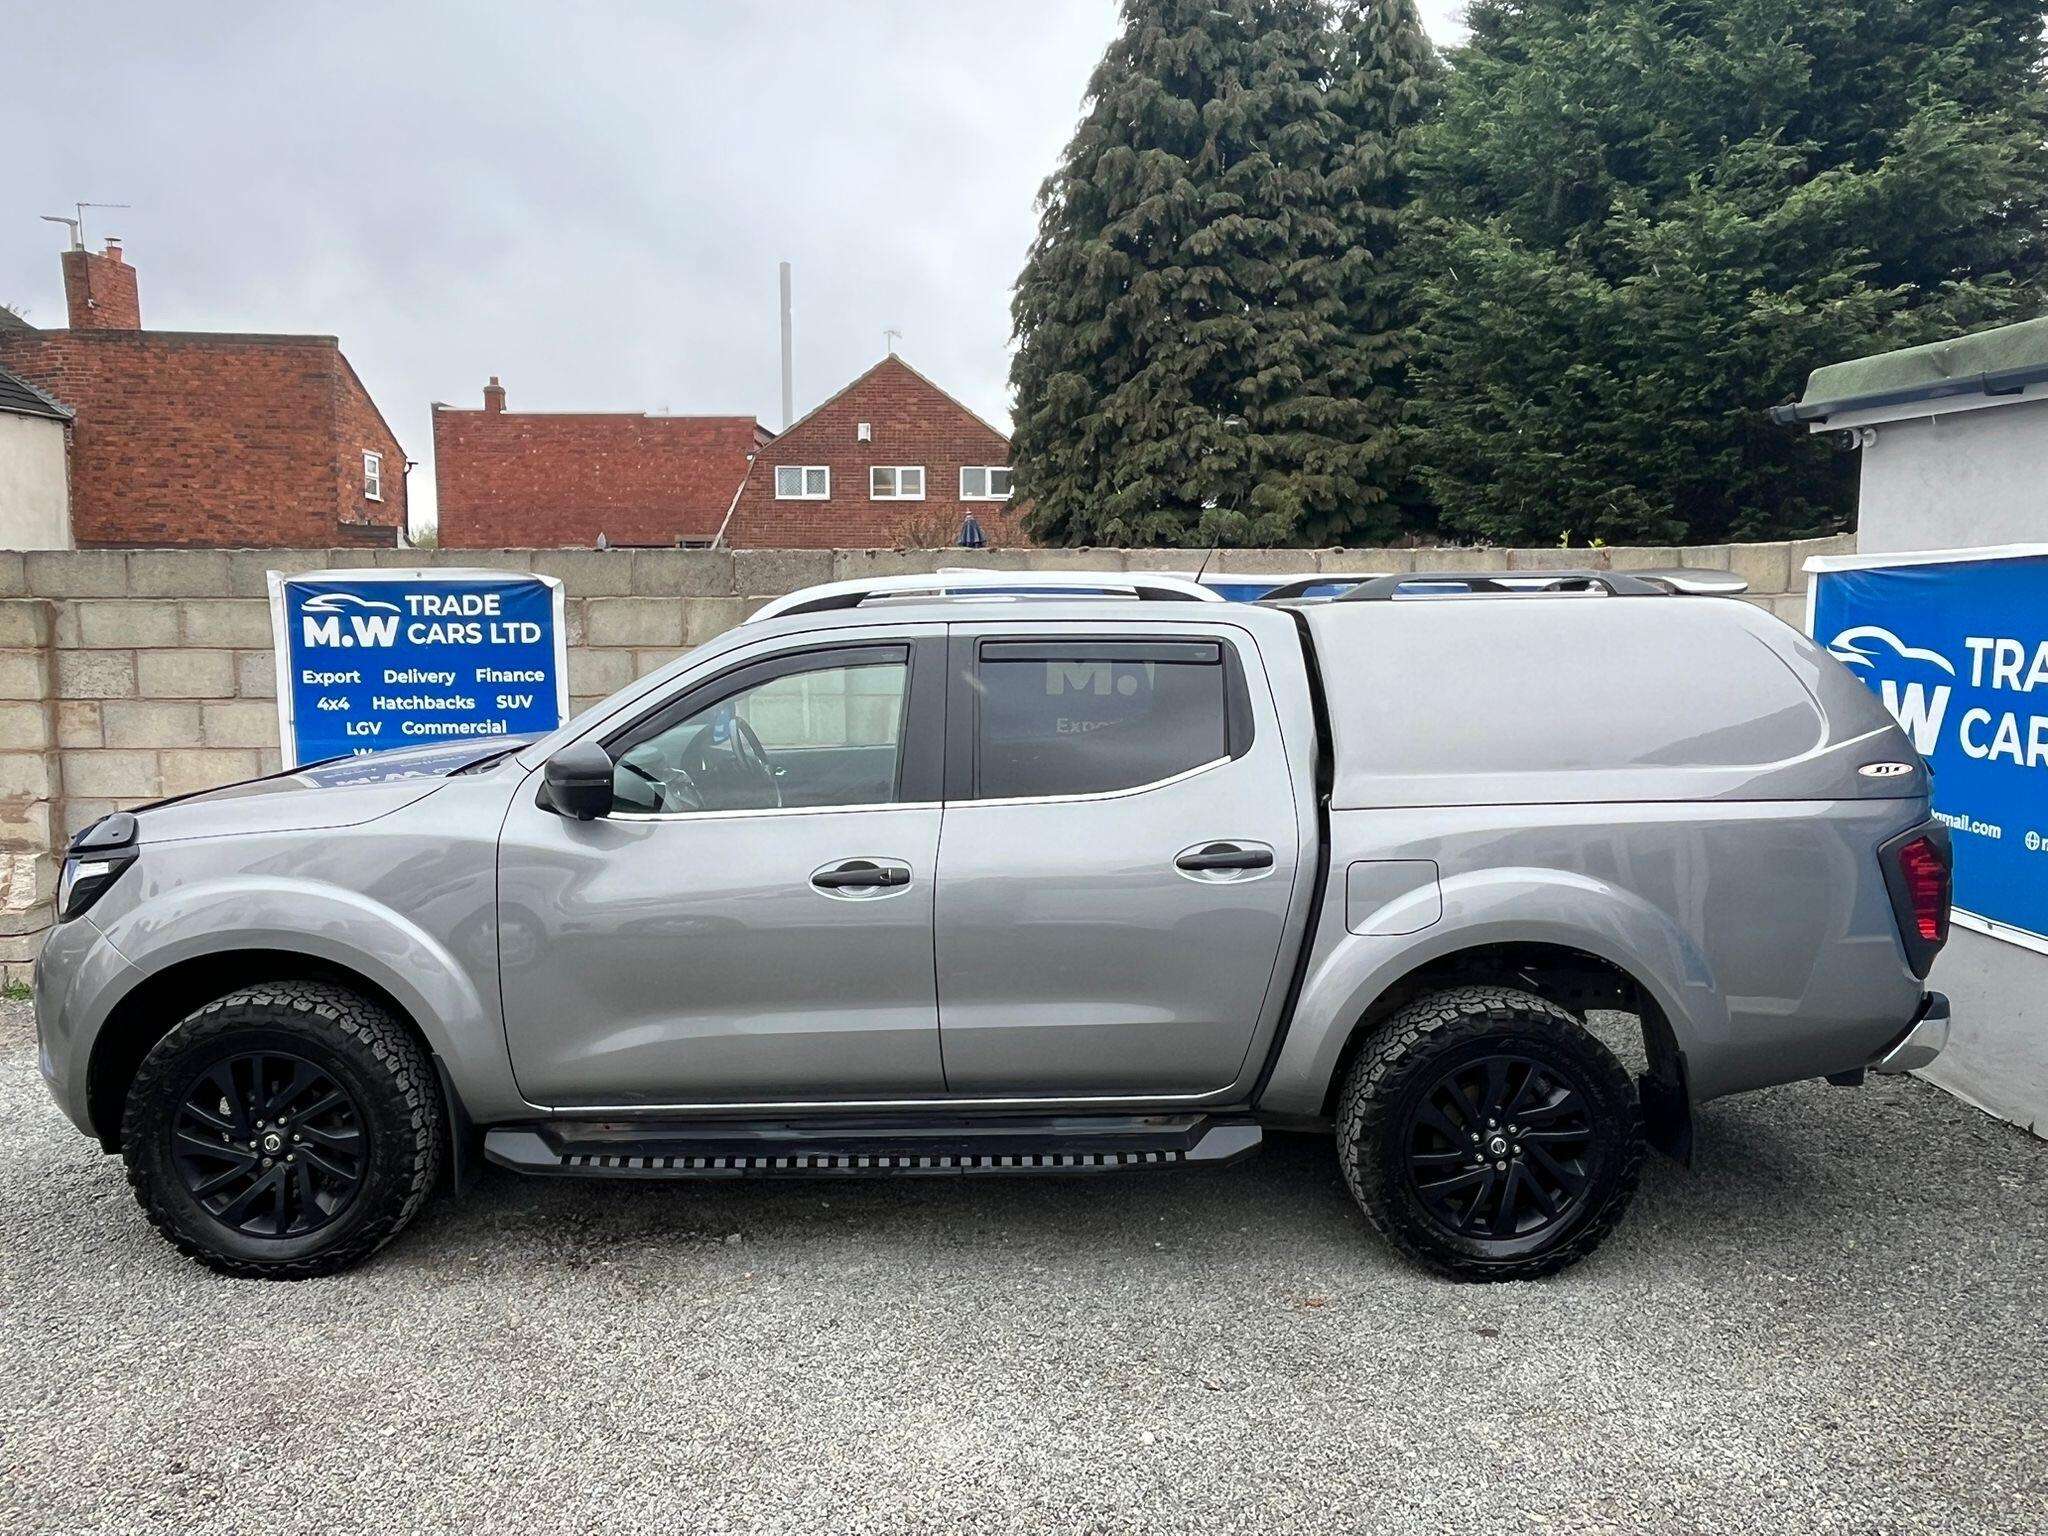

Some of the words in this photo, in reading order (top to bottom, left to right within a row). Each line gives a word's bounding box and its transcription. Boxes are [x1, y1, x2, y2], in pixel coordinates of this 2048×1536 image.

[404, 594, 501, 616] TRADE
[302, 615, 400, 648] M.W
[407, 622, 483, 645] CARS
[490, 622, 542, 644] LTD
[302, 670, 362, 687] Export
[383, 668, 456, 687] Delivery
[475, 667, 545, 683] Finance
[316, 696, 351, 711] 4x4
[372, 694, 476, 710] Hatchbacks
[496, 694, 534, 709] SUV
[346, 721, 382, 736] LGV
[401, 719, 507, 735] Commercial
